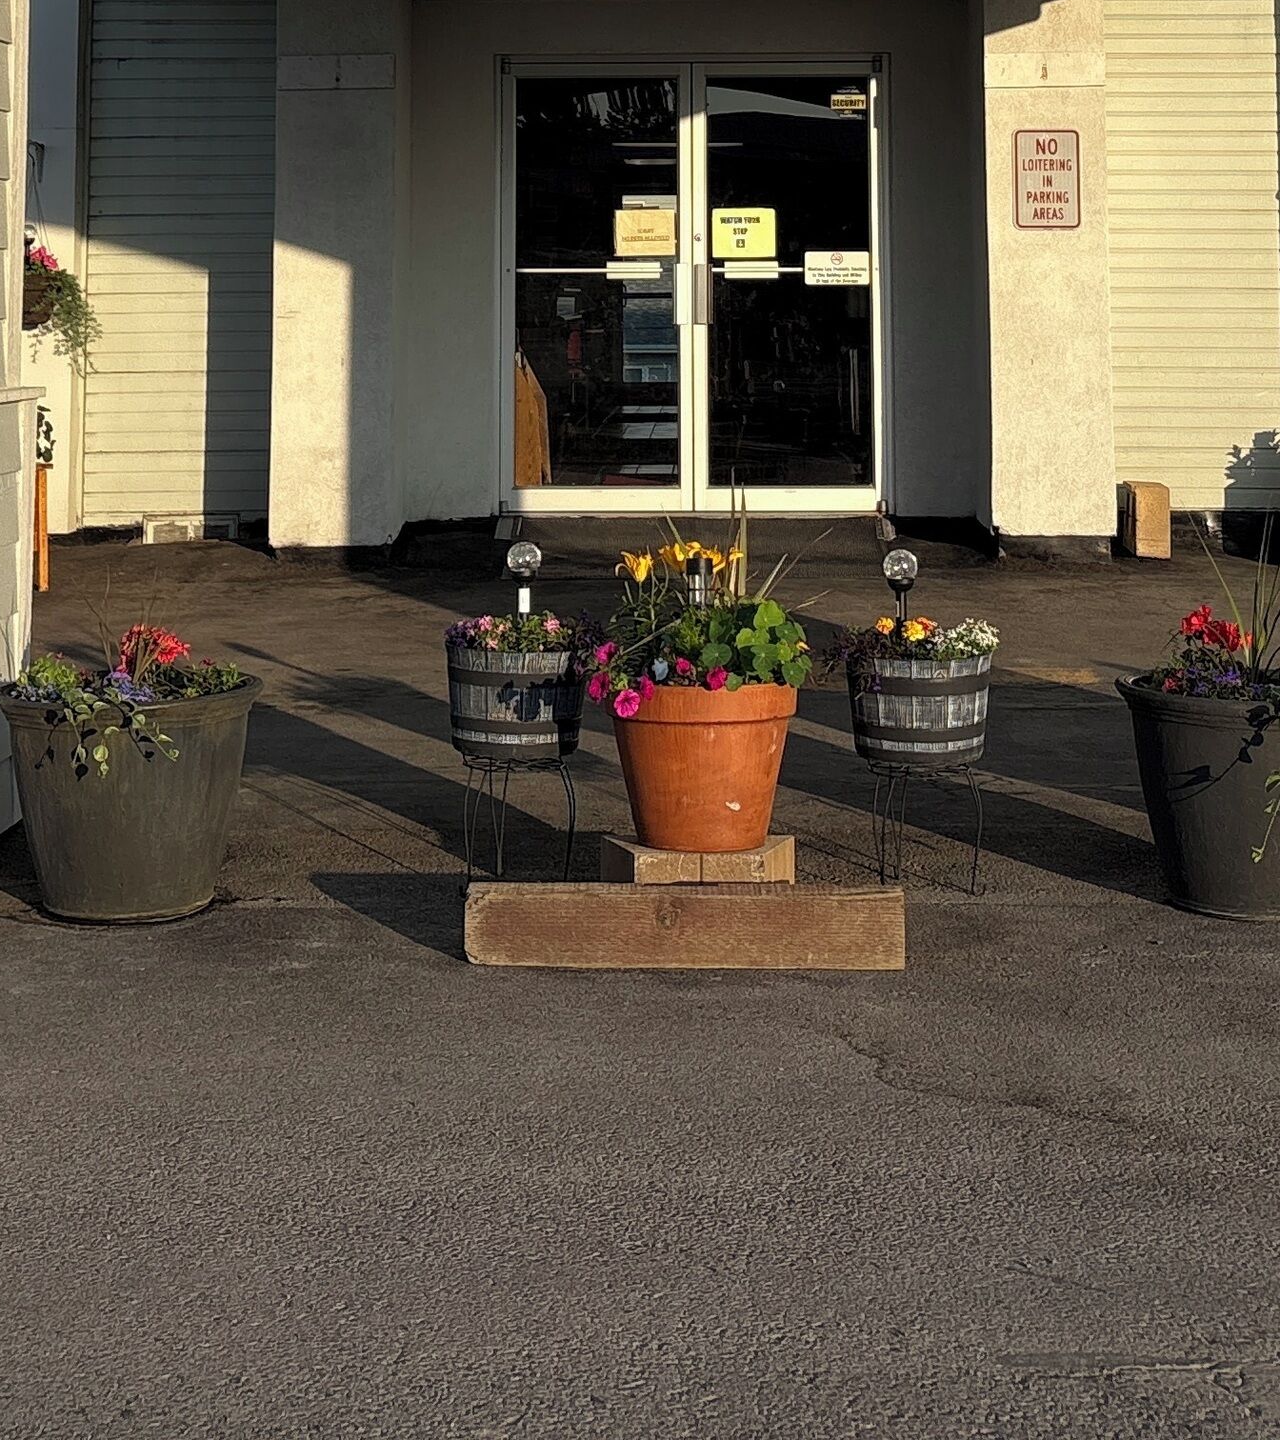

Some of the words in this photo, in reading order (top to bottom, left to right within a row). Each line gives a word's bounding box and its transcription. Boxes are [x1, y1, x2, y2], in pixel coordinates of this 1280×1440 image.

[831, 98, 865, 107] SECURITY
[1035, 138, 1058, 155] NO
[1022, 158, 1072, 172] LOITERING
[1042, 175, 1053, 188] IN
[1026, 191, 1070, 204] PARKING
[1032, 207, 1065, 220] AREAS
